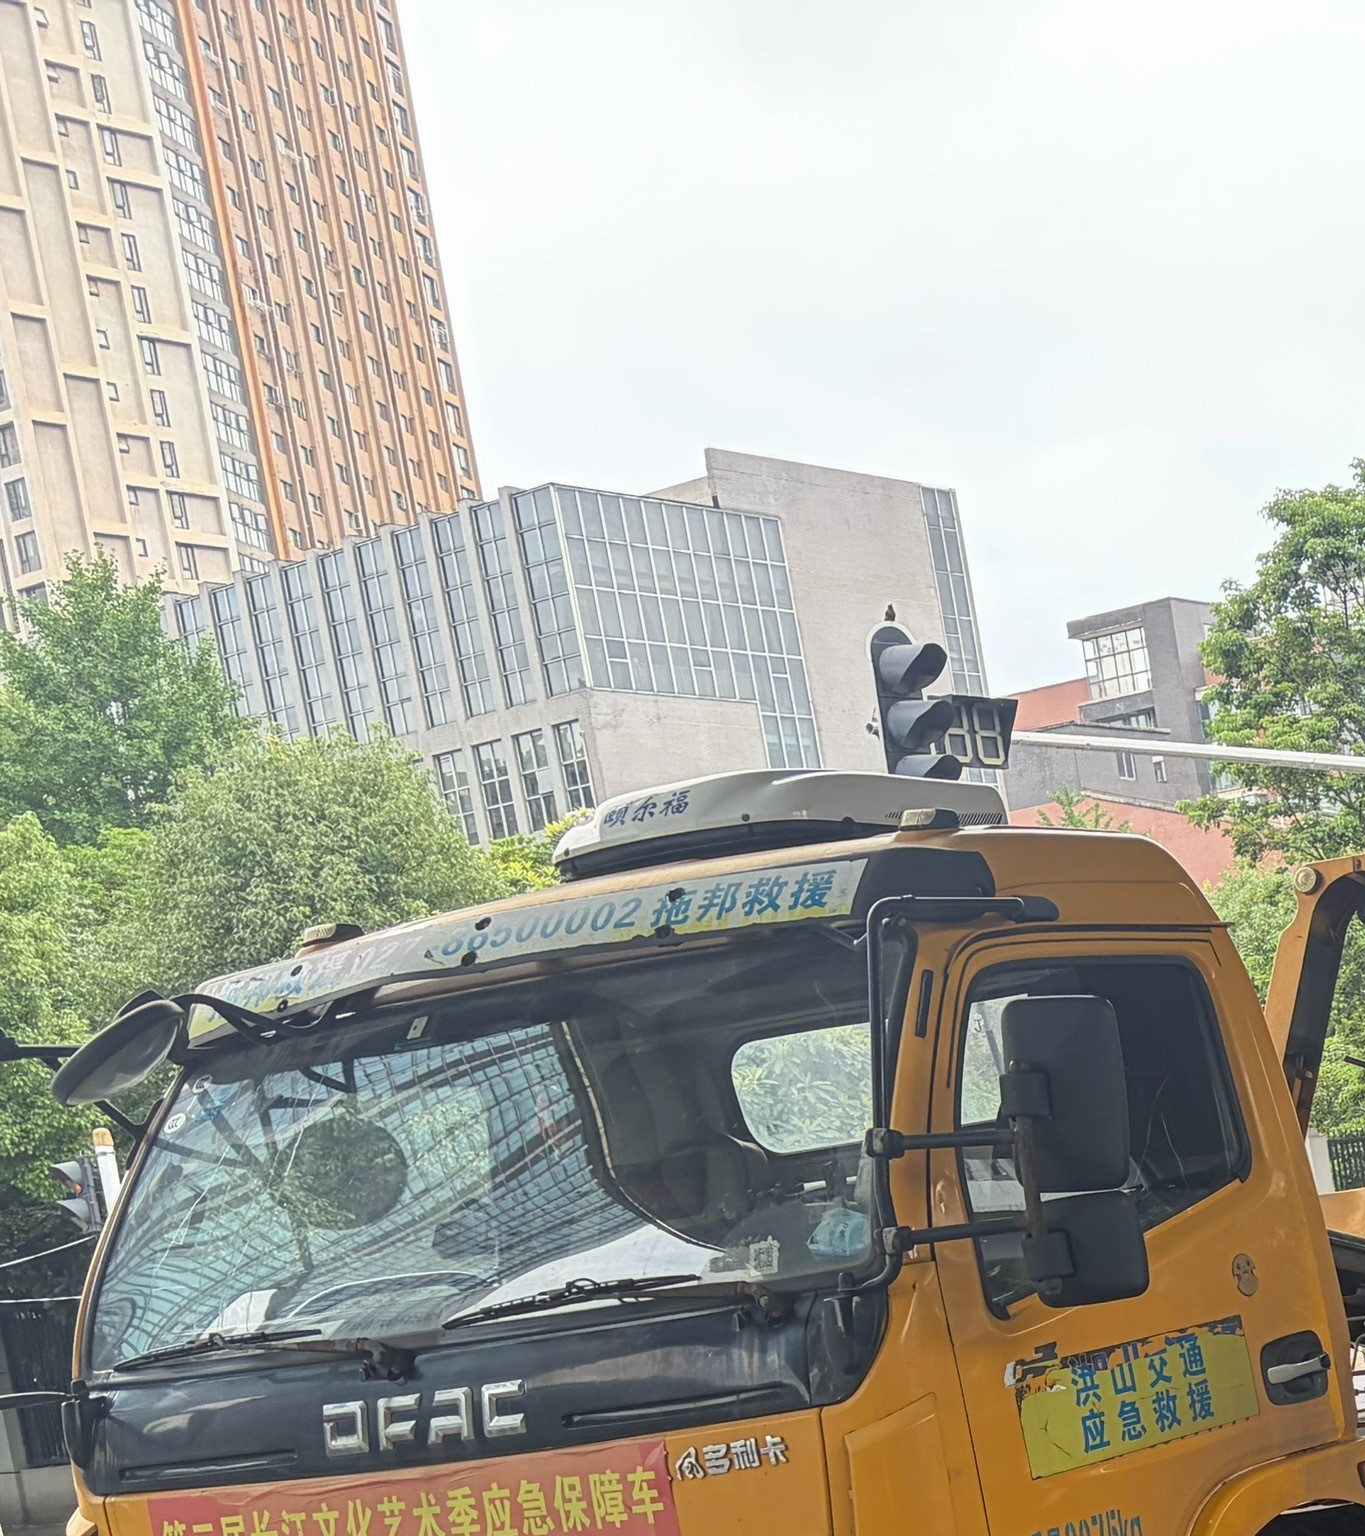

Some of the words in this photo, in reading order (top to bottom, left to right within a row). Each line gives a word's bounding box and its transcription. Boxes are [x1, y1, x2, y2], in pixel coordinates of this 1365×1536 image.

[650, 868, 838, 928] 拖邦救援
[1070, 1333, 1208, 1408] 洪山交通
[322, 1378, 528, 1457] DFAC
[1081, 1382, 1216, 1454] 应急救援
